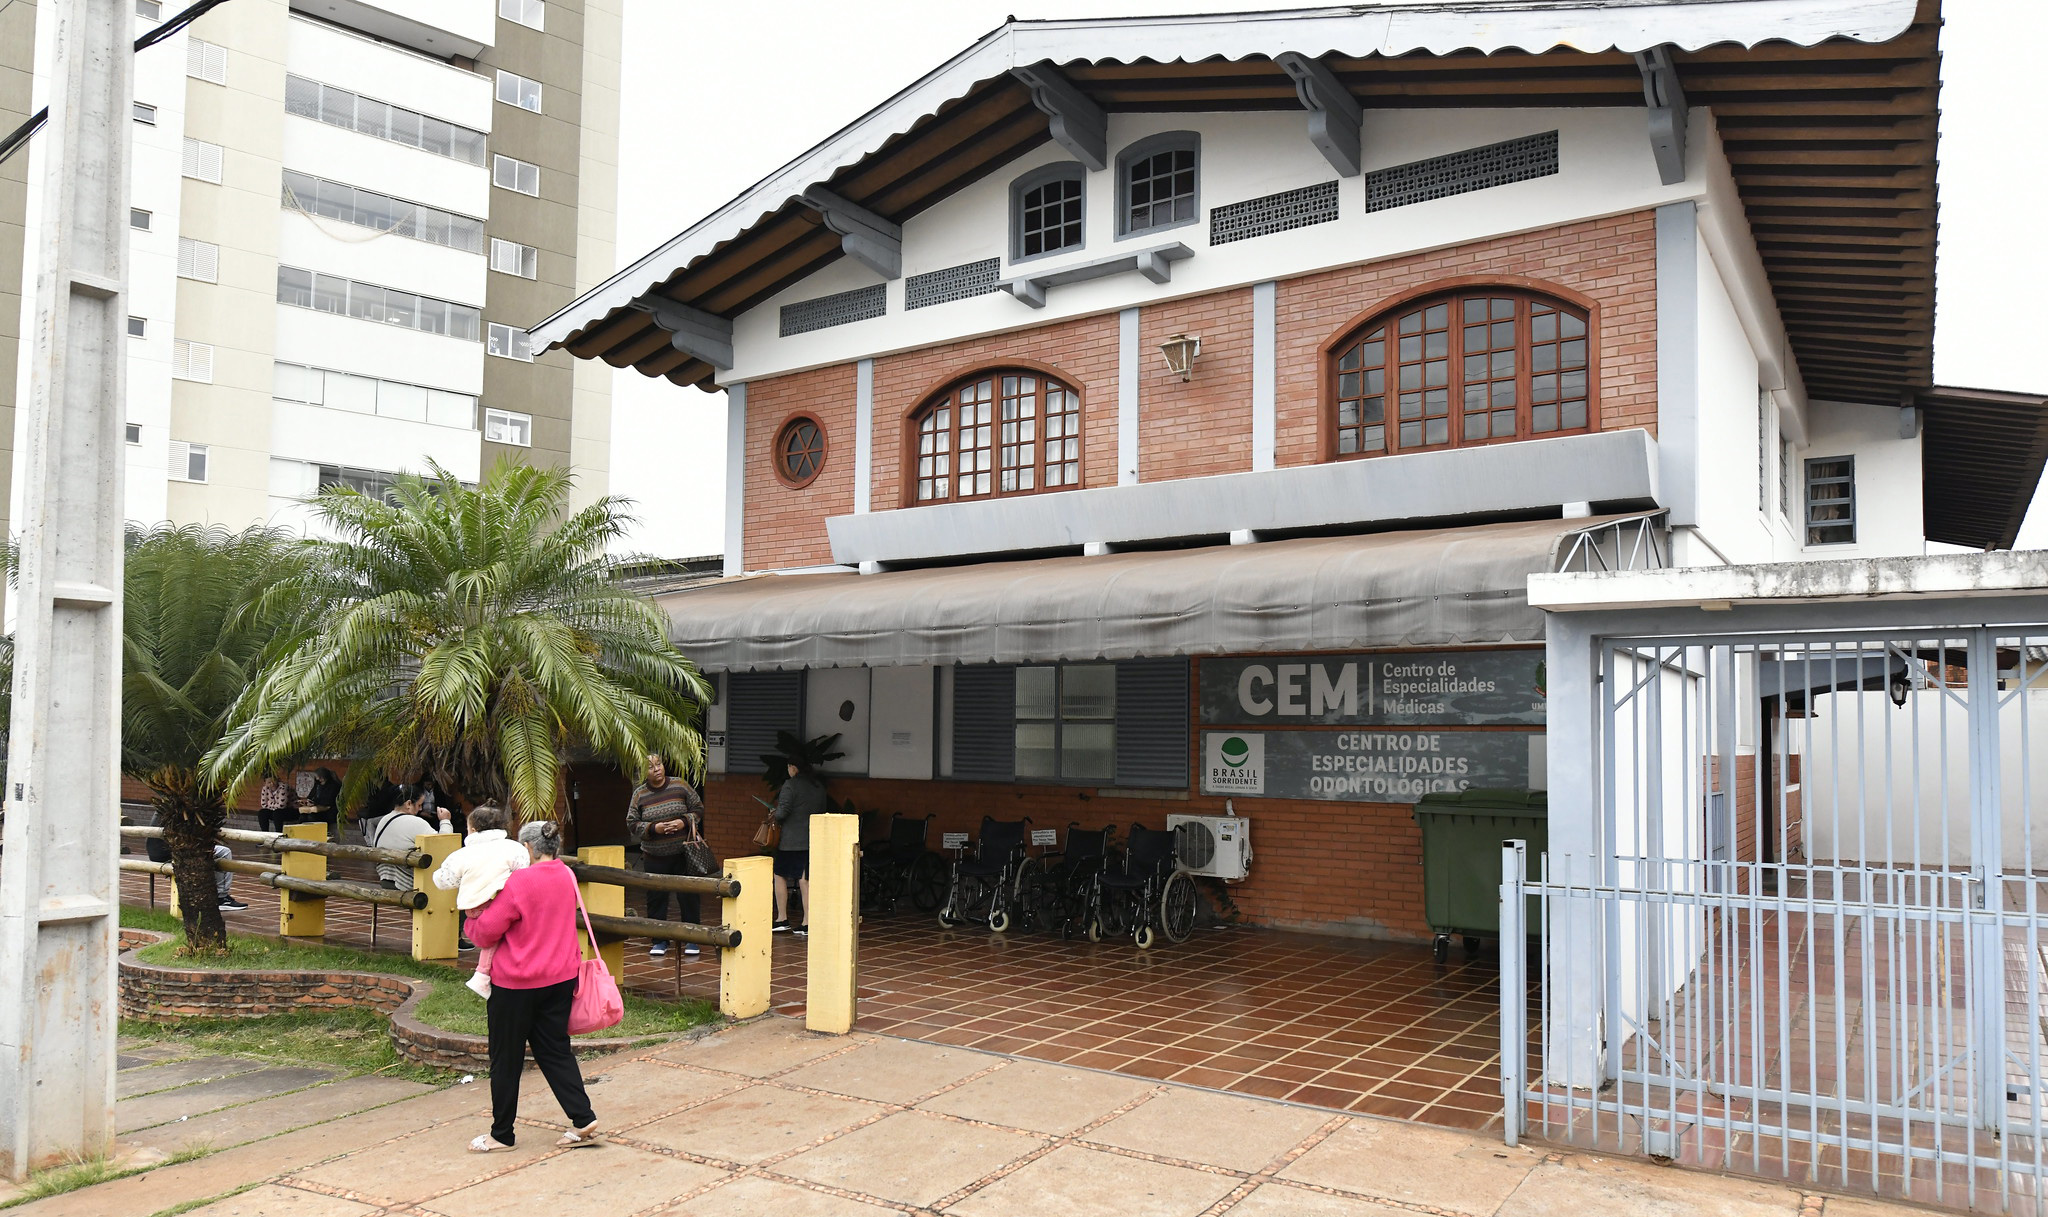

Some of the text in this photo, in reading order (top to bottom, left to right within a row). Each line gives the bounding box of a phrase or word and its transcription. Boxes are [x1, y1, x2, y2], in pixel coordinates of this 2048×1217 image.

[1383, 661, 1456, 677] Centro de
[1238, 663, 1358, 716] CEM
[1383, 678, 1496, 697] Especialidades
[1383, 698, 1445, 714] Médicas
[1531, 702, 1546, 711] UM
[1337, 734, 1441, 752] CENTRO DE
[1213, 768, 1258, 778] BRASIL
[1312, 755, 1469, 774] ESPECIALIDADES
[1213, 777, 1257, 785] SORRIDENTE
[1310, 773, 1469, 795] ODONTOLÓGICAS
